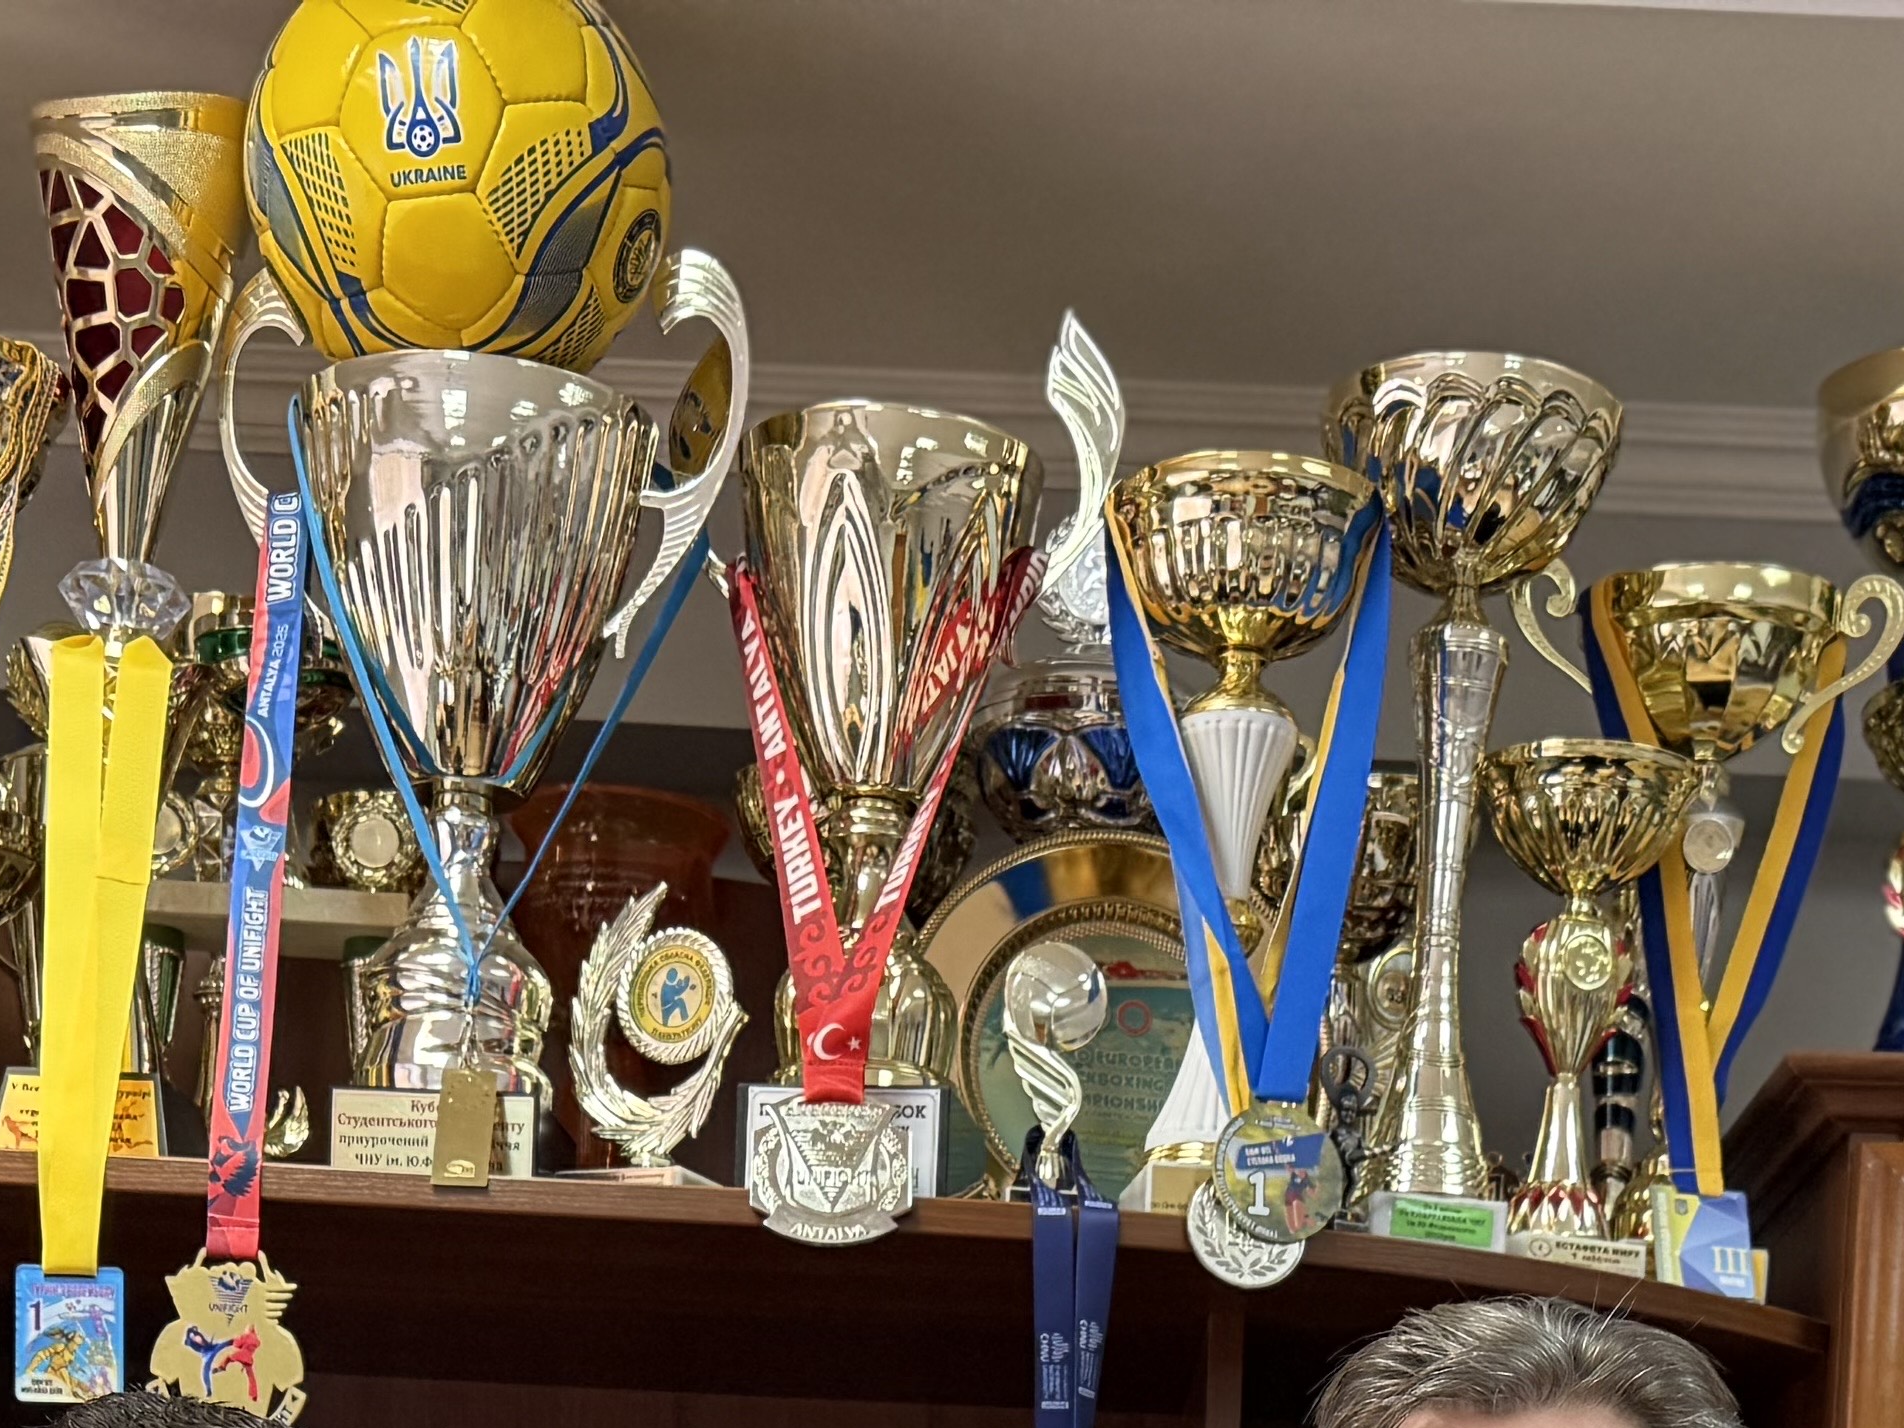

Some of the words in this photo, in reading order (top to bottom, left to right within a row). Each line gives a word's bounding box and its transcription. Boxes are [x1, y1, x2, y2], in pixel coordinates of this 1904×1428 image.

[390, 164, 467, 187] UKRAINE
[268, 519, 299, 603] WORLD
[257, 658, 281, 719] ANTALYA
[271, 624, 290, 658] 2025
[741, 609, 787, 761] ANTALYA
[775, 794, 822, 924] TURKEY
[239, 887, 269, 972] UNIFIGHT
[236, 974, 263, 1003] OF
[233, 1003, 259, 1042] CUP
[229, 1045, 257, 1113] WORLD
[339, 1135, 429, 1148] приурочений
[355, 1153, 382, 1166] ЧНУ
[1247, 1171, 1270, 1216] 1
[789, 1222, 867, 1241] ANTALYA
[29, 1300, 43, 1331] 1
